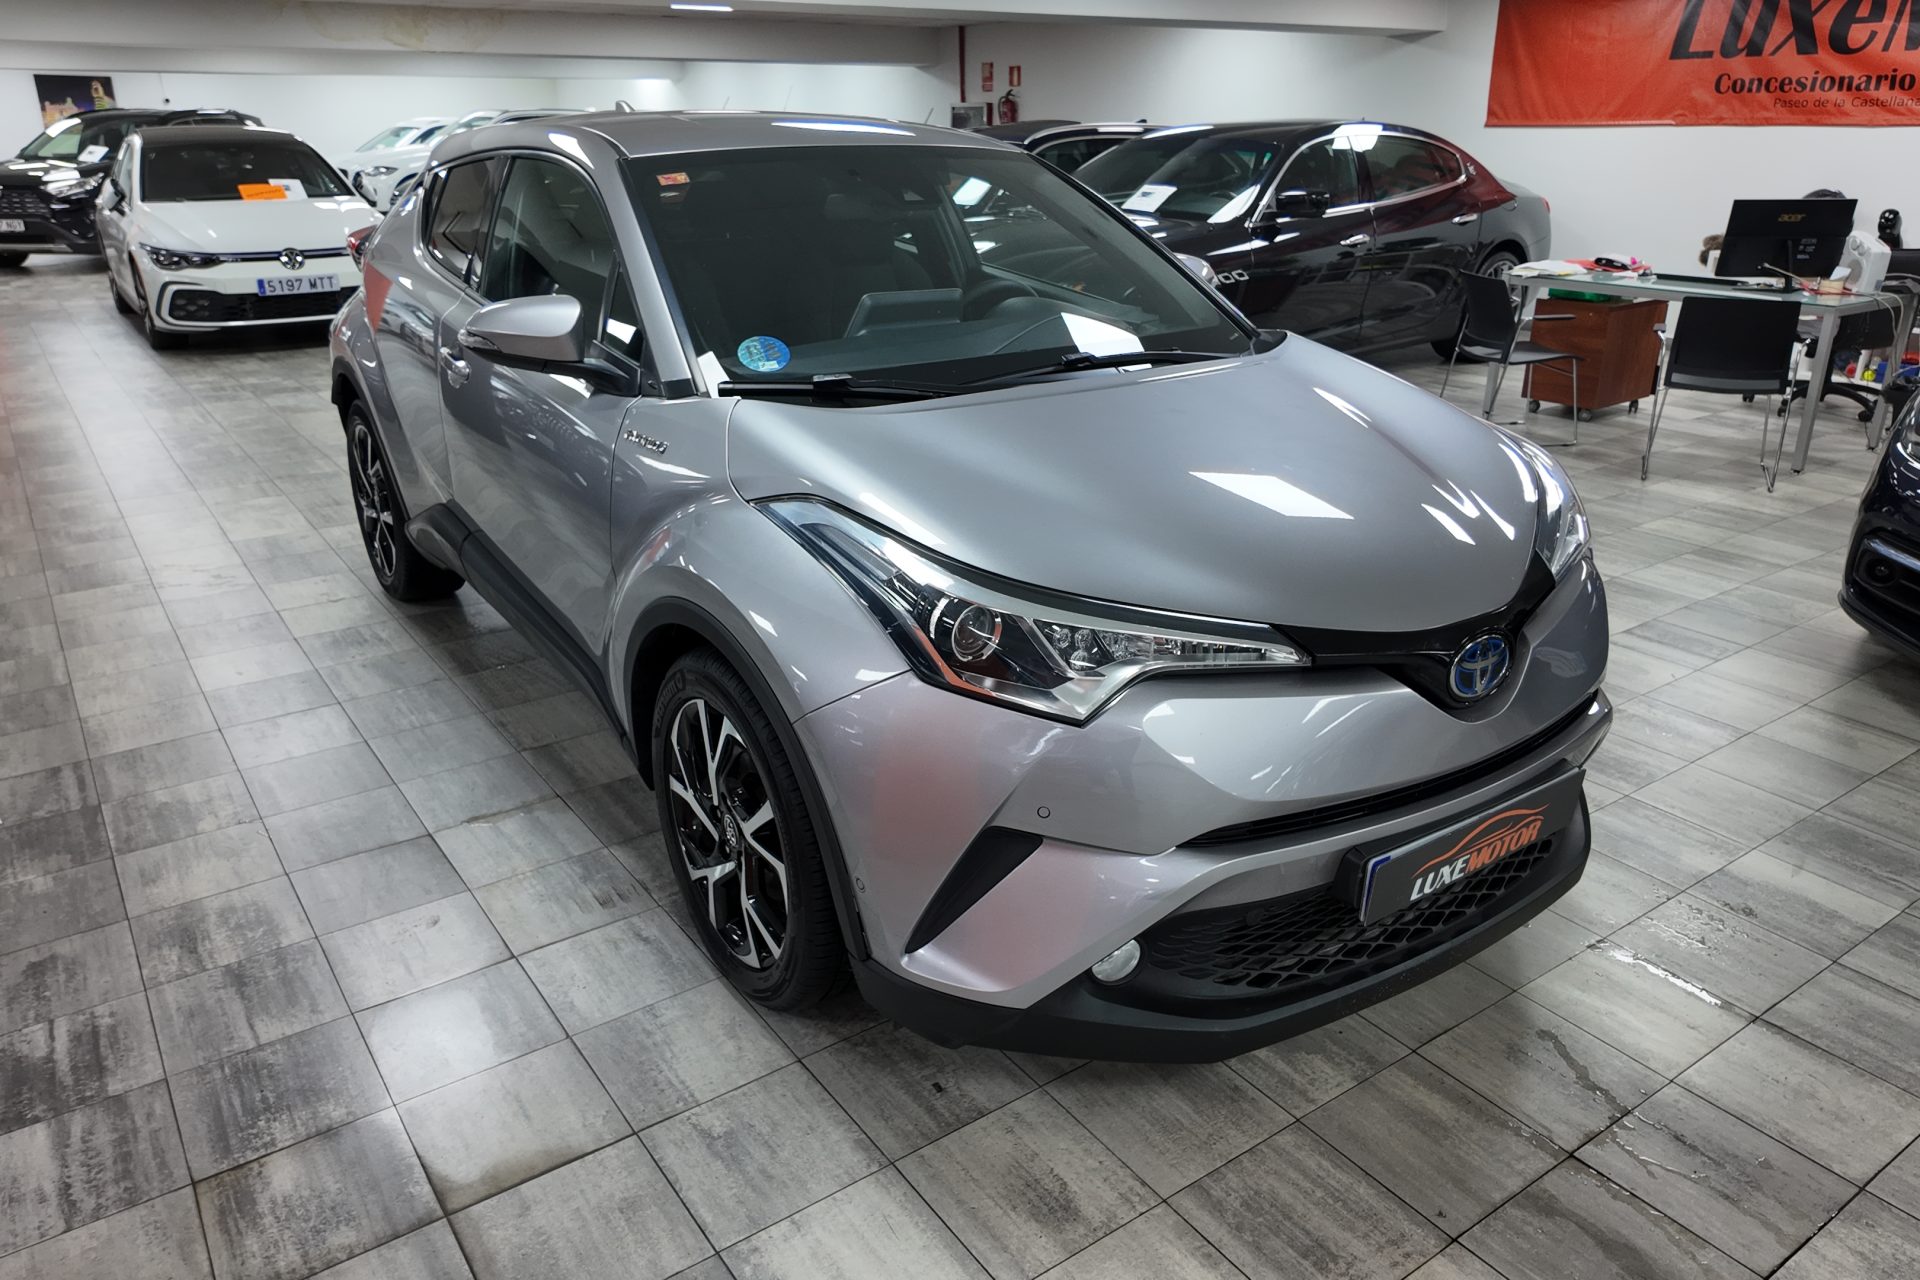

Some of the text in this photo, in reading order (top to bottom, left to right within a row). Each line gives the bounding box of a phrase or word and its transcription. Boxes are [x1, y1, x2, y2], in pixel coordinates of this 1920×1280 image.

[1714, 68, 1916, 95] Concesionario
[1773, 96, 1920, 108] Paseo de la Castellana
[267, 276, 334, 293] 5197 MTT
[1410, 820, 1541, 901] LUXEMOTOR
